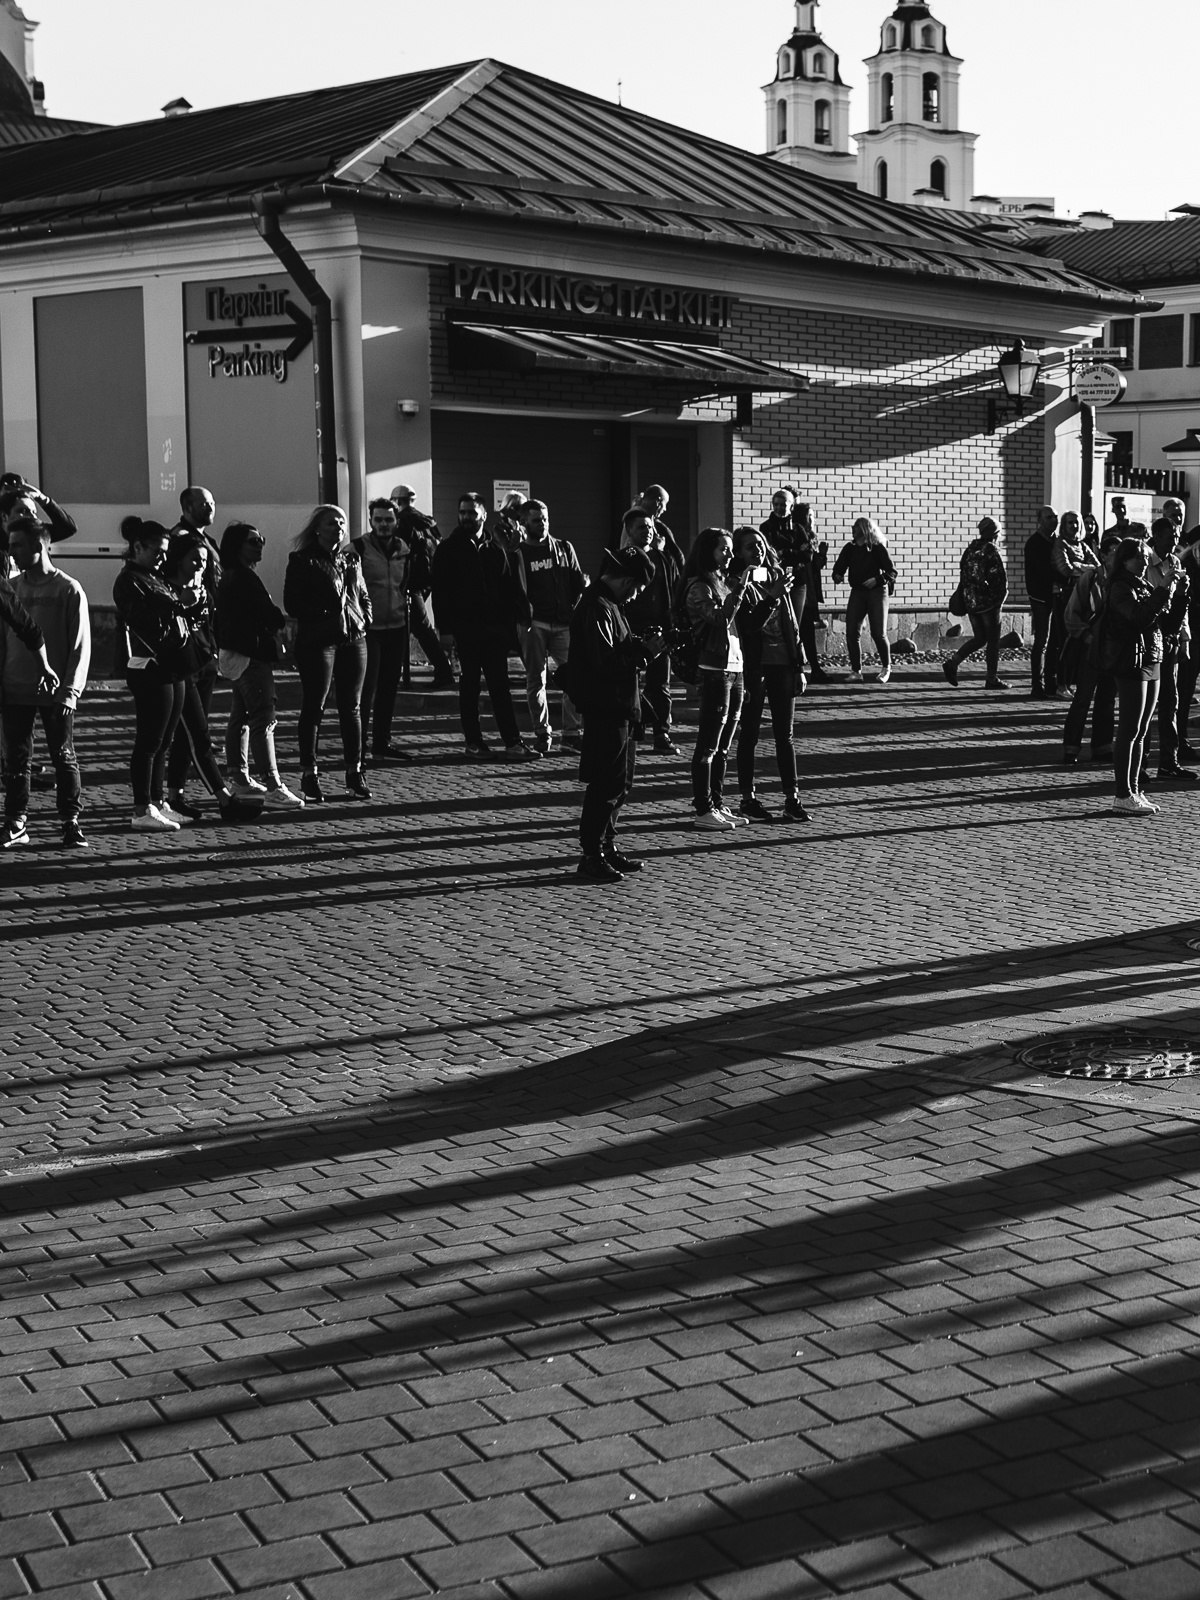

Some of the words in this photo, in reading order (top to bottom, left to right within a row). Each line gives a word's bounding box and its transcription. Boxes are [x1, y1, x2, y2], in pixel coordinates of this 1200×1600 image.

[206, 283, 289, 326] Паркінг
[452, 261, 600, 314] PARKING
[616, 283, 738, 328] ПАРКІНГ
[208, 343, 287, 383] Parking
